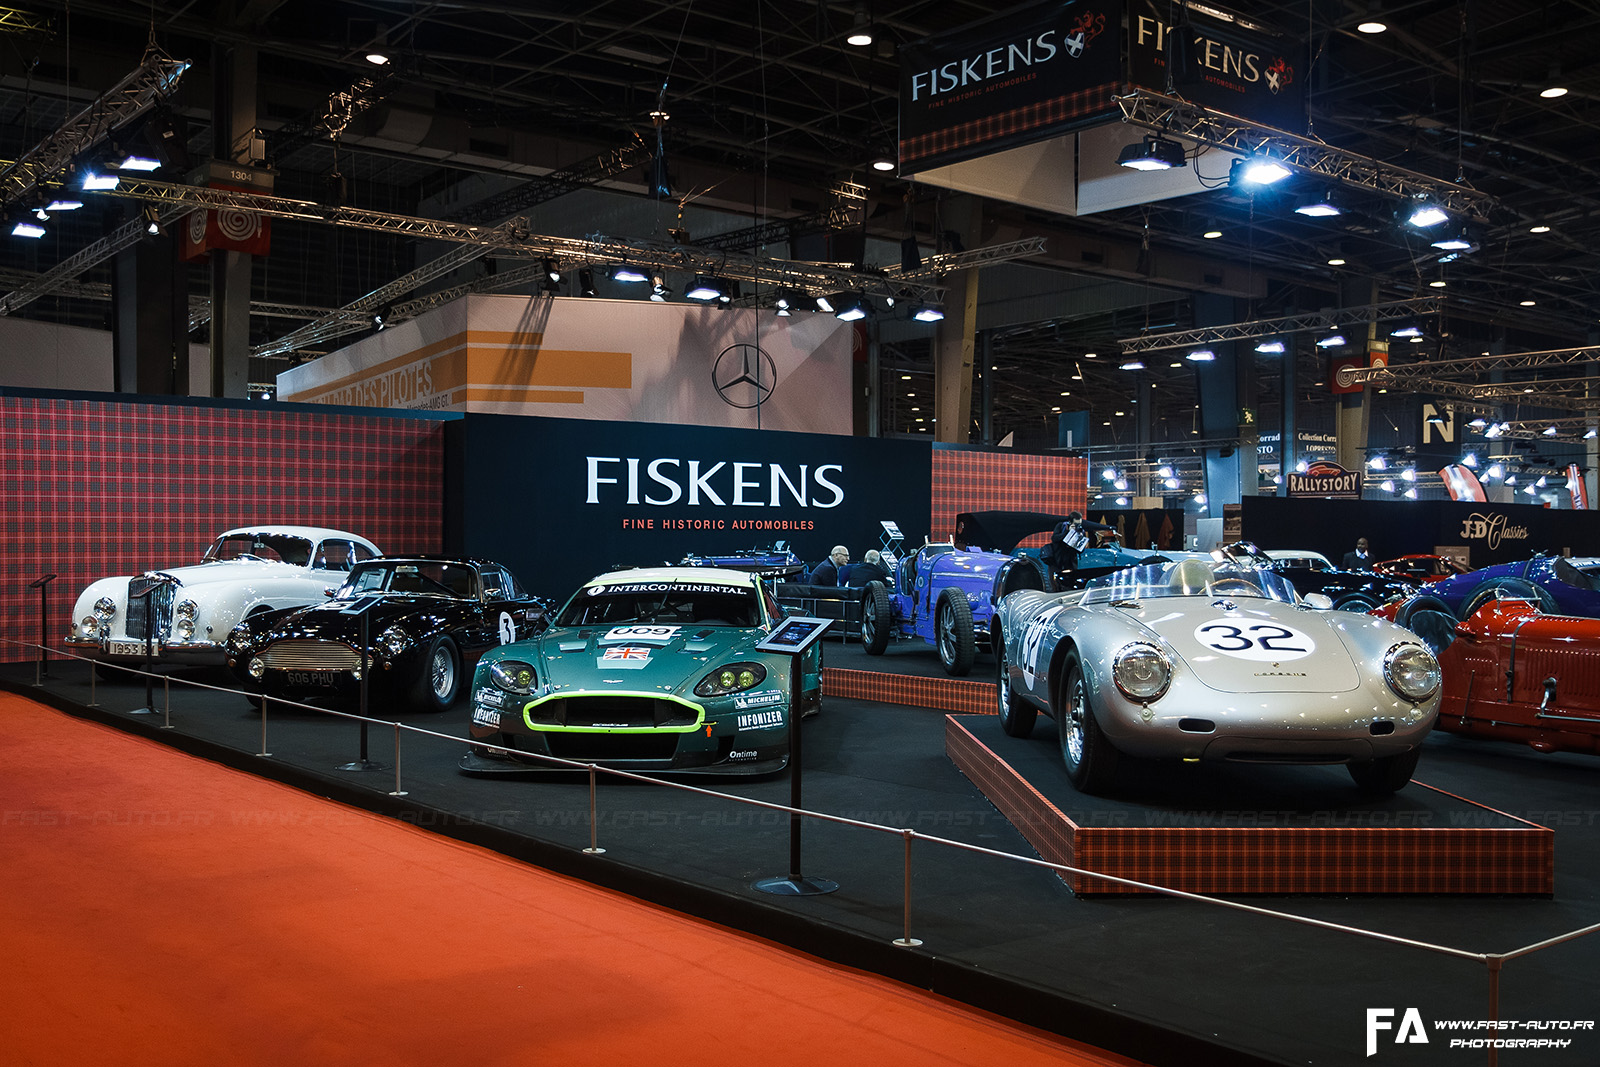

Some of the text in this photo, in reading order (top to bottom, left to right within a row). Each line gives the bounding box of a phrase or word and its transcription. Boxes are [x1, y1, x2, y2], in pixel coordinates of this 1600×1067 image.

[1137, 15, 1260, 83] FIENS
[911, 30, 1057, 102] FISKENS
[928, 72, 1038, 110] FINE HISTORIC AUTOMOBILES
[1204, 74, 1246, 94] AUTOMOBILES
[230, 170, 252, 182] 1304
[585, 456, 845, 509] FISKENS
[1290, 473, 1358, 492] RALLYSTORY
[622, 518, 815, 531] FINE HISTORIC AUTOMOBILES
[1487, 512, 1529, 550] Classics
[503, 618, 512, 644] 3
[1200, 625, 1308, 653] 32
[287, 672, 334, 684] 606 PHU
[747, 694, 781, 704] MICHELIN
[737, 710, 783, 728] INFONIZER
[729, 750, 758, 759] Ontime
